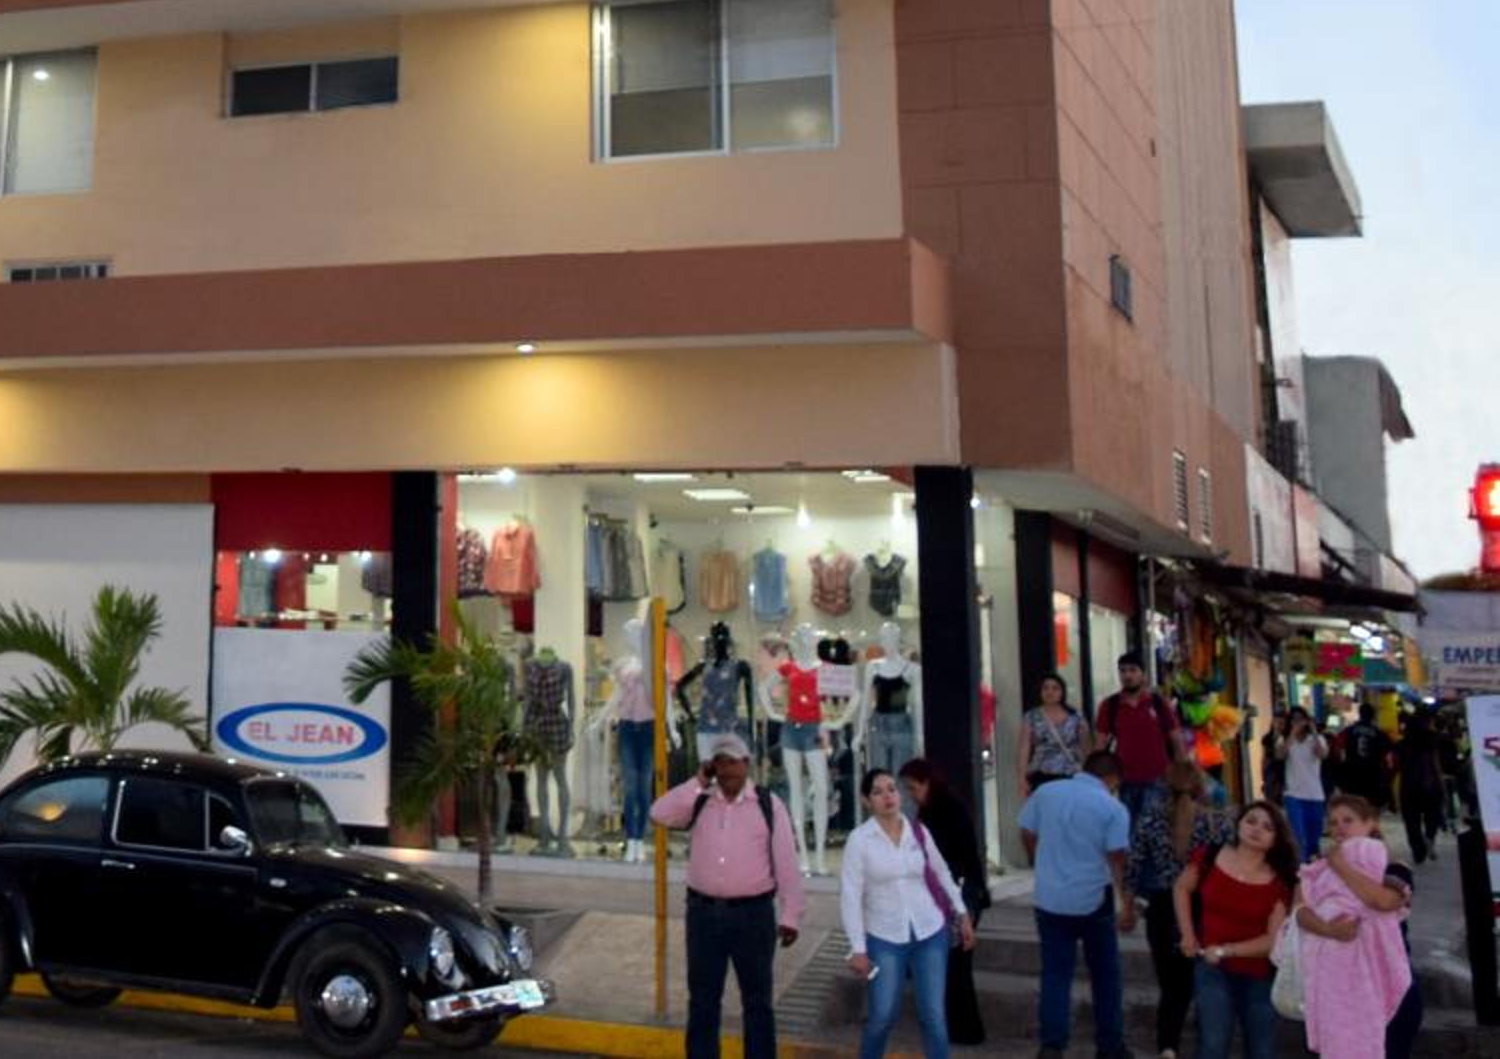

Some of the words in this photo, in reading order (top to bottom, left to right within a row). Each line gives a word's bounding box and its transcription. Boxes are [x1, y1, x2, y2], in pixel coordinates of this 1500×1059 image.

[1443, 646, 1500, 664] EMPE
[249, 721, 277, 741] EL
[287, 722, 355, 746] JEAN
